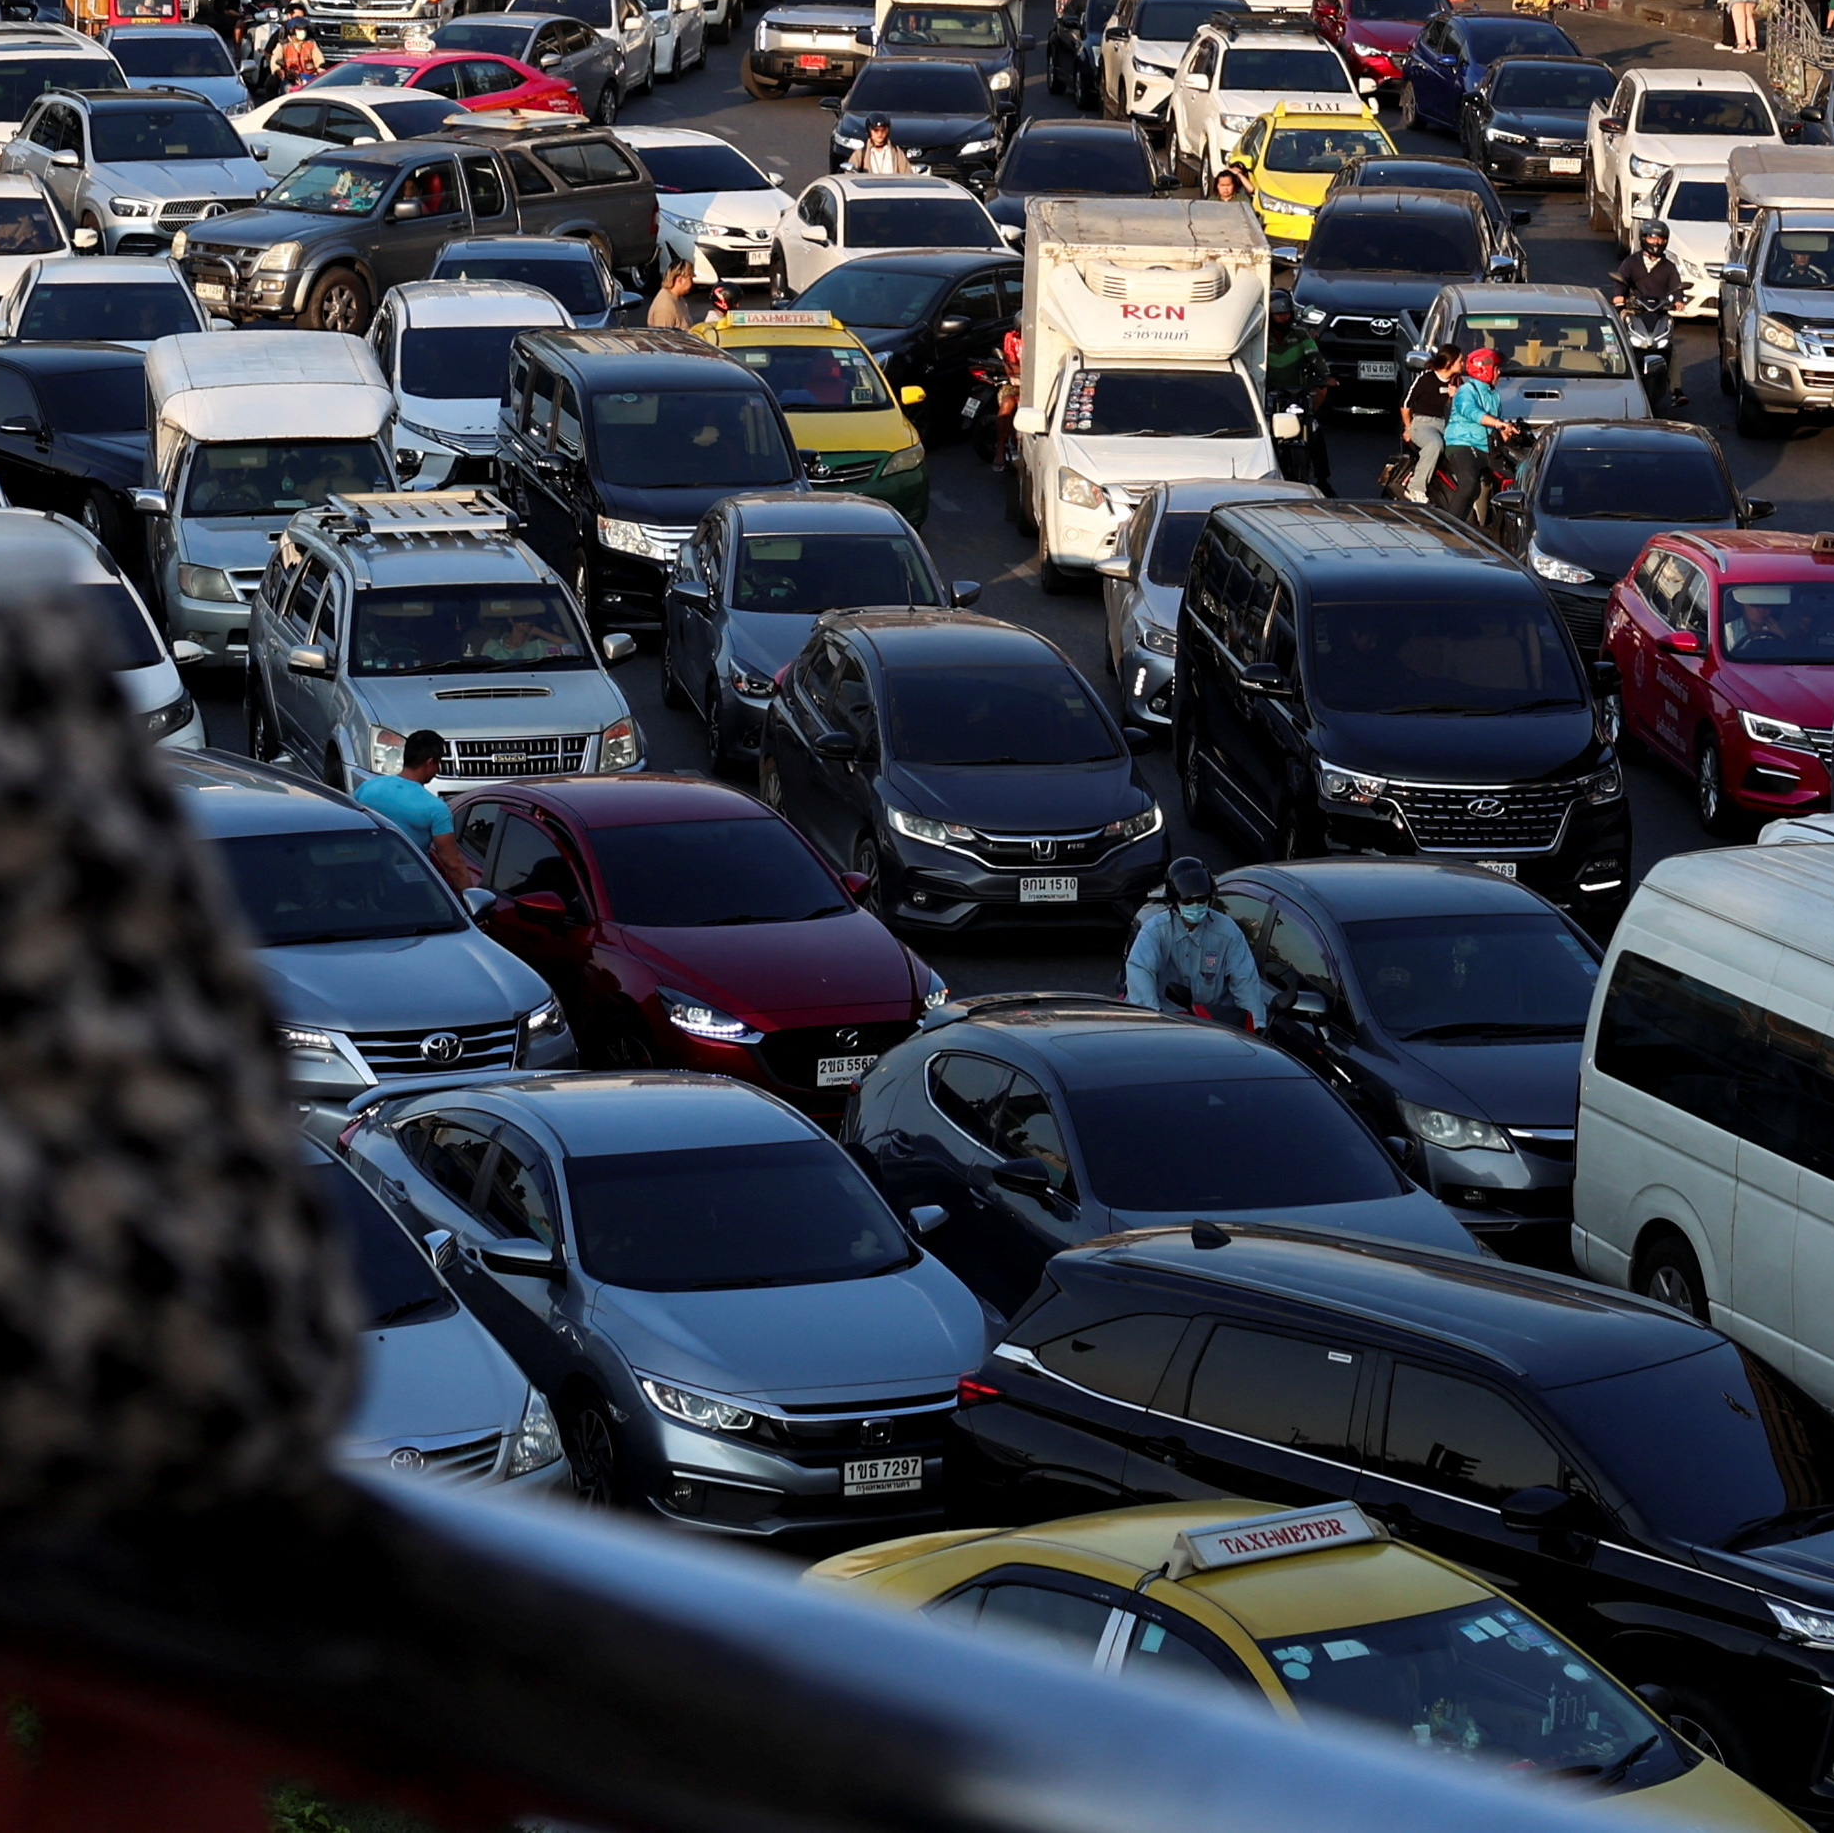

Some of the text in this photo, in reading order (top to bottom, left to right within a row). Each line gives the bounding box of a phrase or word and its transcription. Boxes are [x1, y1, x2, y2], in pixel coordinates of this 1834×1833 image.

[1306, 103, 1340, 112] TAXI
[1120, 304, 1185, 320] RCN
[747, 314, 815, 324] TAXI-METER
[495, 754, 524, 762] ISUZU
[1022, 879, 1076, 891] 9กน 1510
[848, 1458, 920, 1481] 1ขธ 7297
[855, 1480, 911, 1494] กรุงเทพมหานคร
[1219, 1518, 1347, 1554] TAXI-METER
